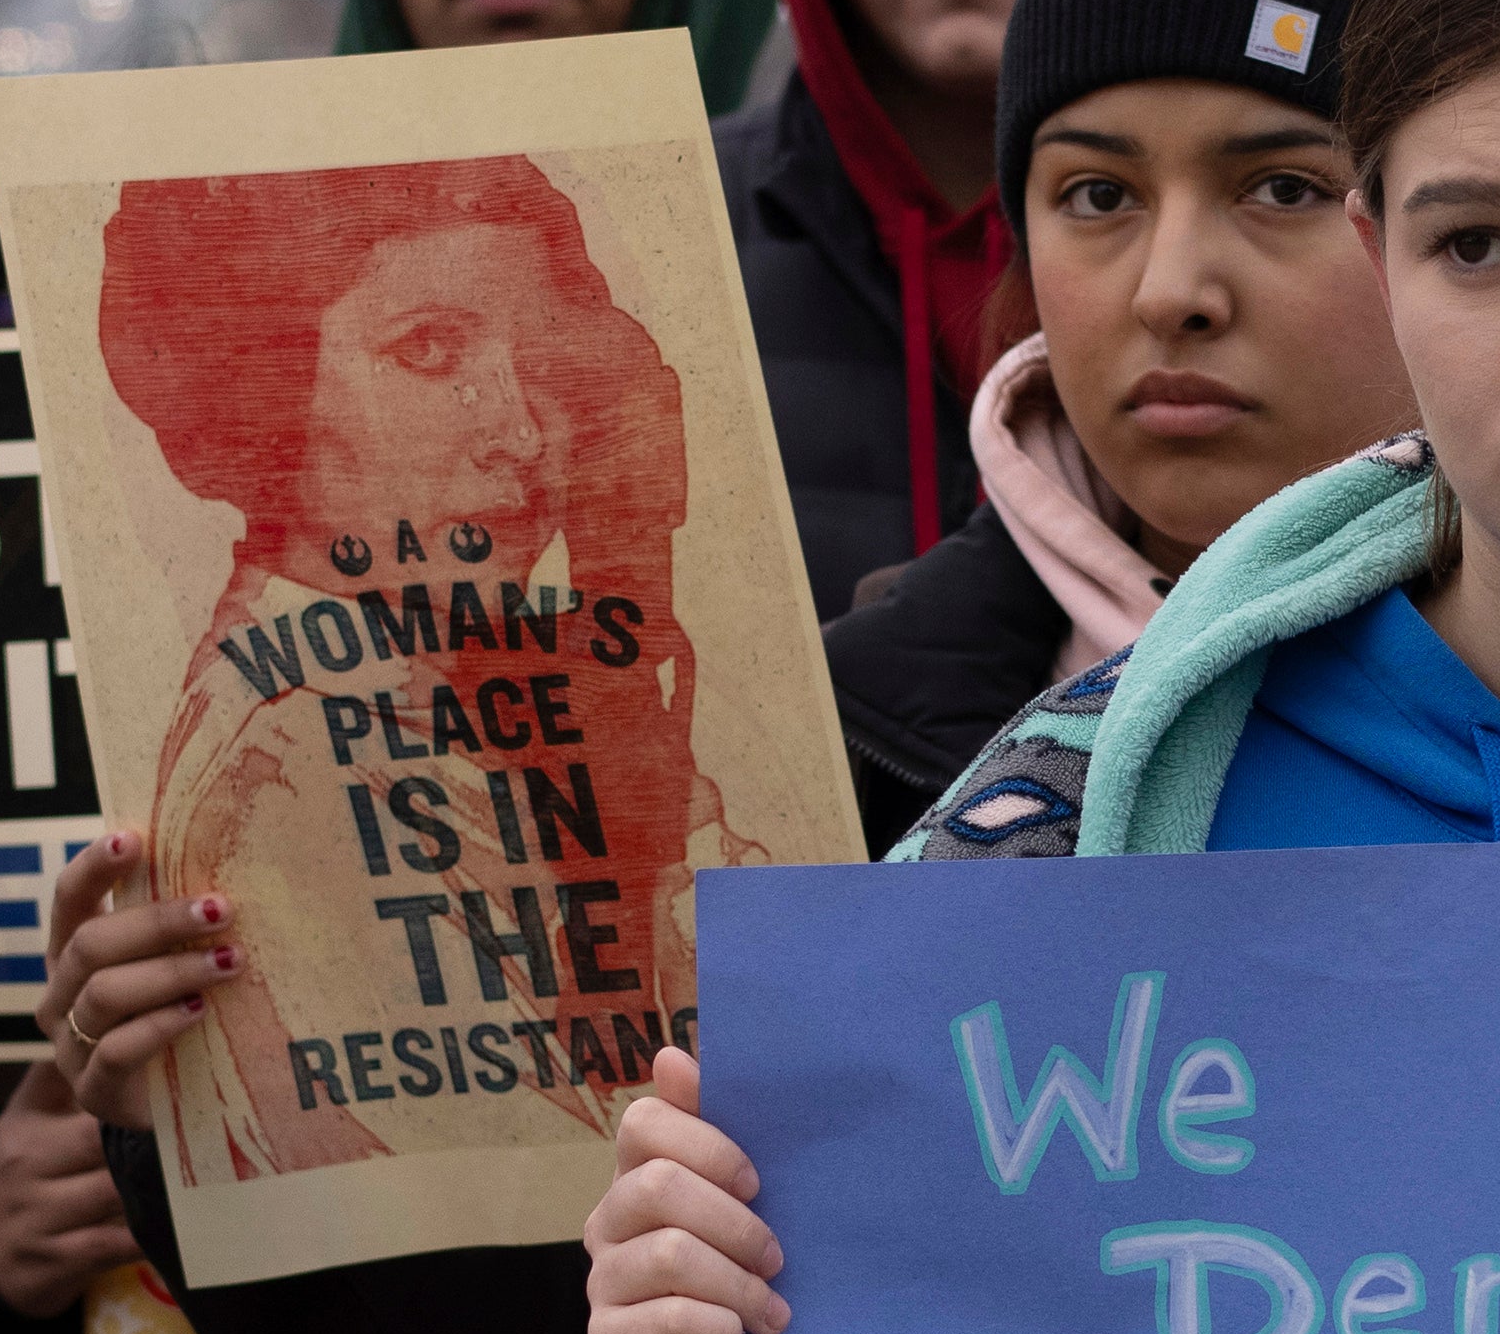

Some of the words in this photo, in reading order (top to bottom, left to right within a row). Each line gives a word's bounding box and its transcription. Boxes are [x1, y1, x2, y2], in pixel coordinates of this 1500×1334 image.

[396, 520, 429, 565] A
[219, 580, 645, 704] WOMAN'S
[321, 673, 585, 767] PLACE
[347, 775, 462, 877] IS
[491, 763, 608, 866] IN
[376, 879, 642, 1007] THE
[950, 969, 1257, 1194] We
